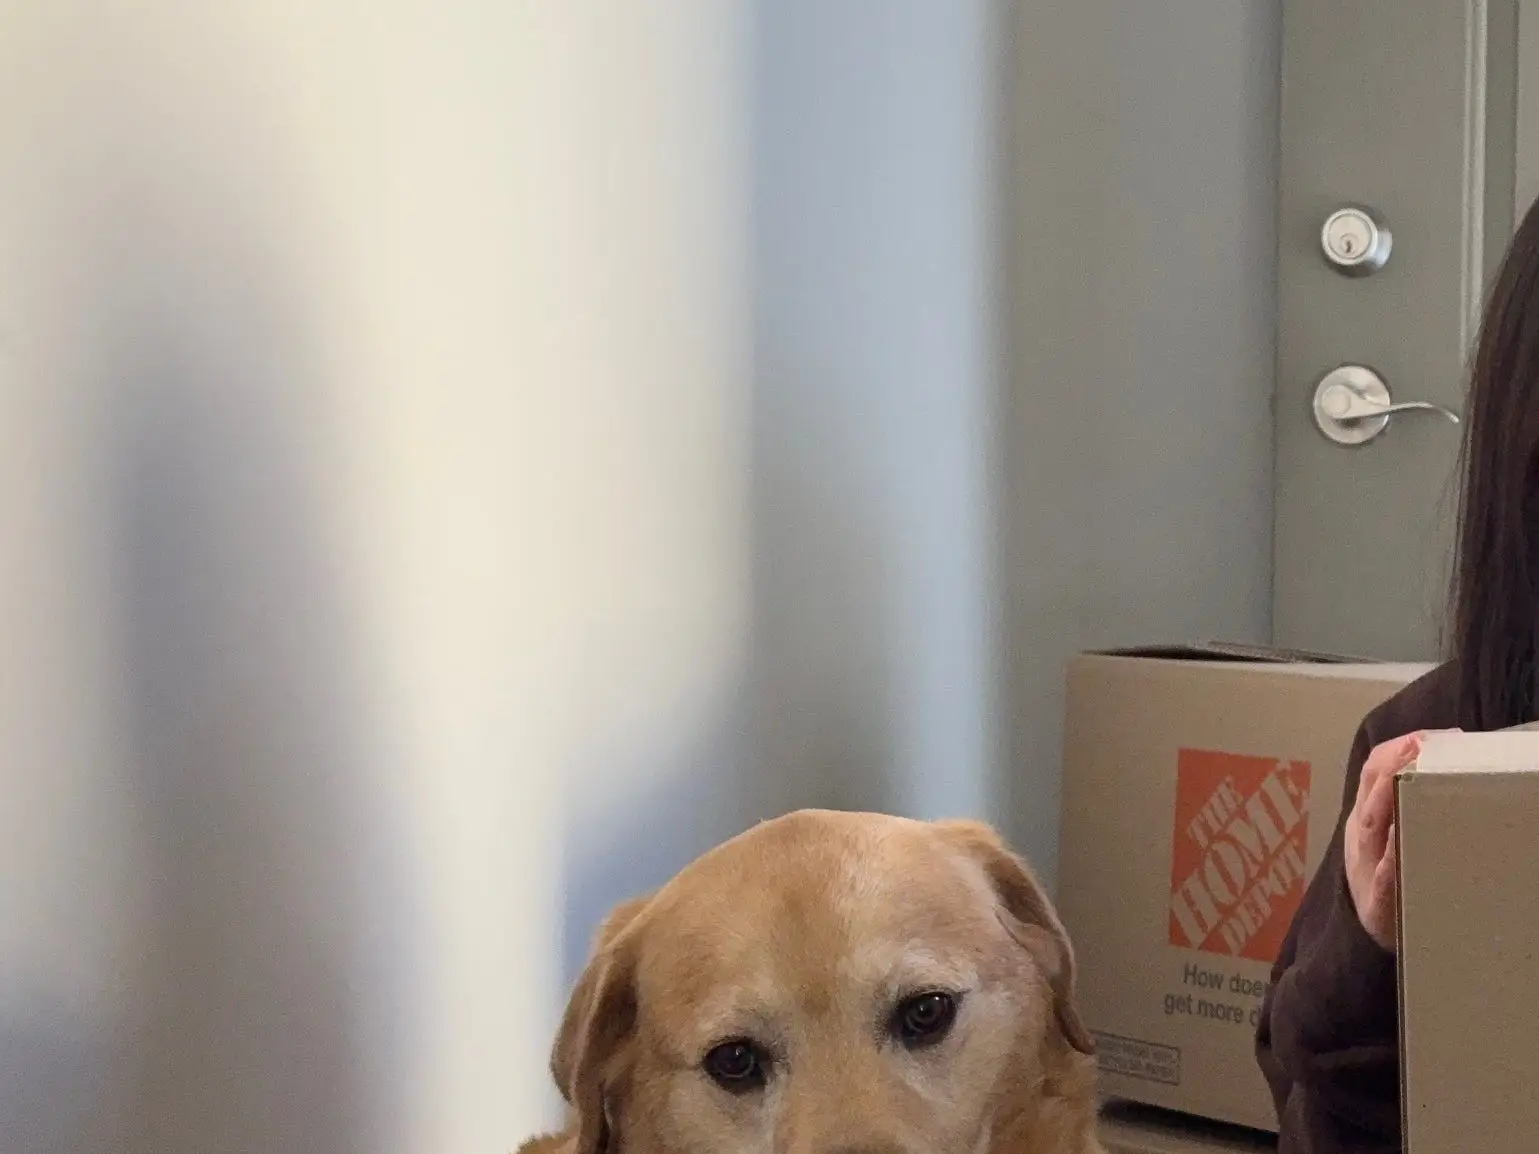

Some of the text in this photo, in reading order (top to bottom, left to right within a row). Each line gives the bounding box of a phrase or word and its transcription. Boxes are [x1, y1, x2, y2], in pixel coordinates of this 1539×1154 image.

[1188, 773, 1244, 850] THE
[1171, 757, 1310, 950] HOME
[1220, 837, 1306, 957] DEPOT
[1164, 993, 1193, 1016] get
[1198, 999, 1244, 1024] more
[1183, 963, 1265, 998] How doe
